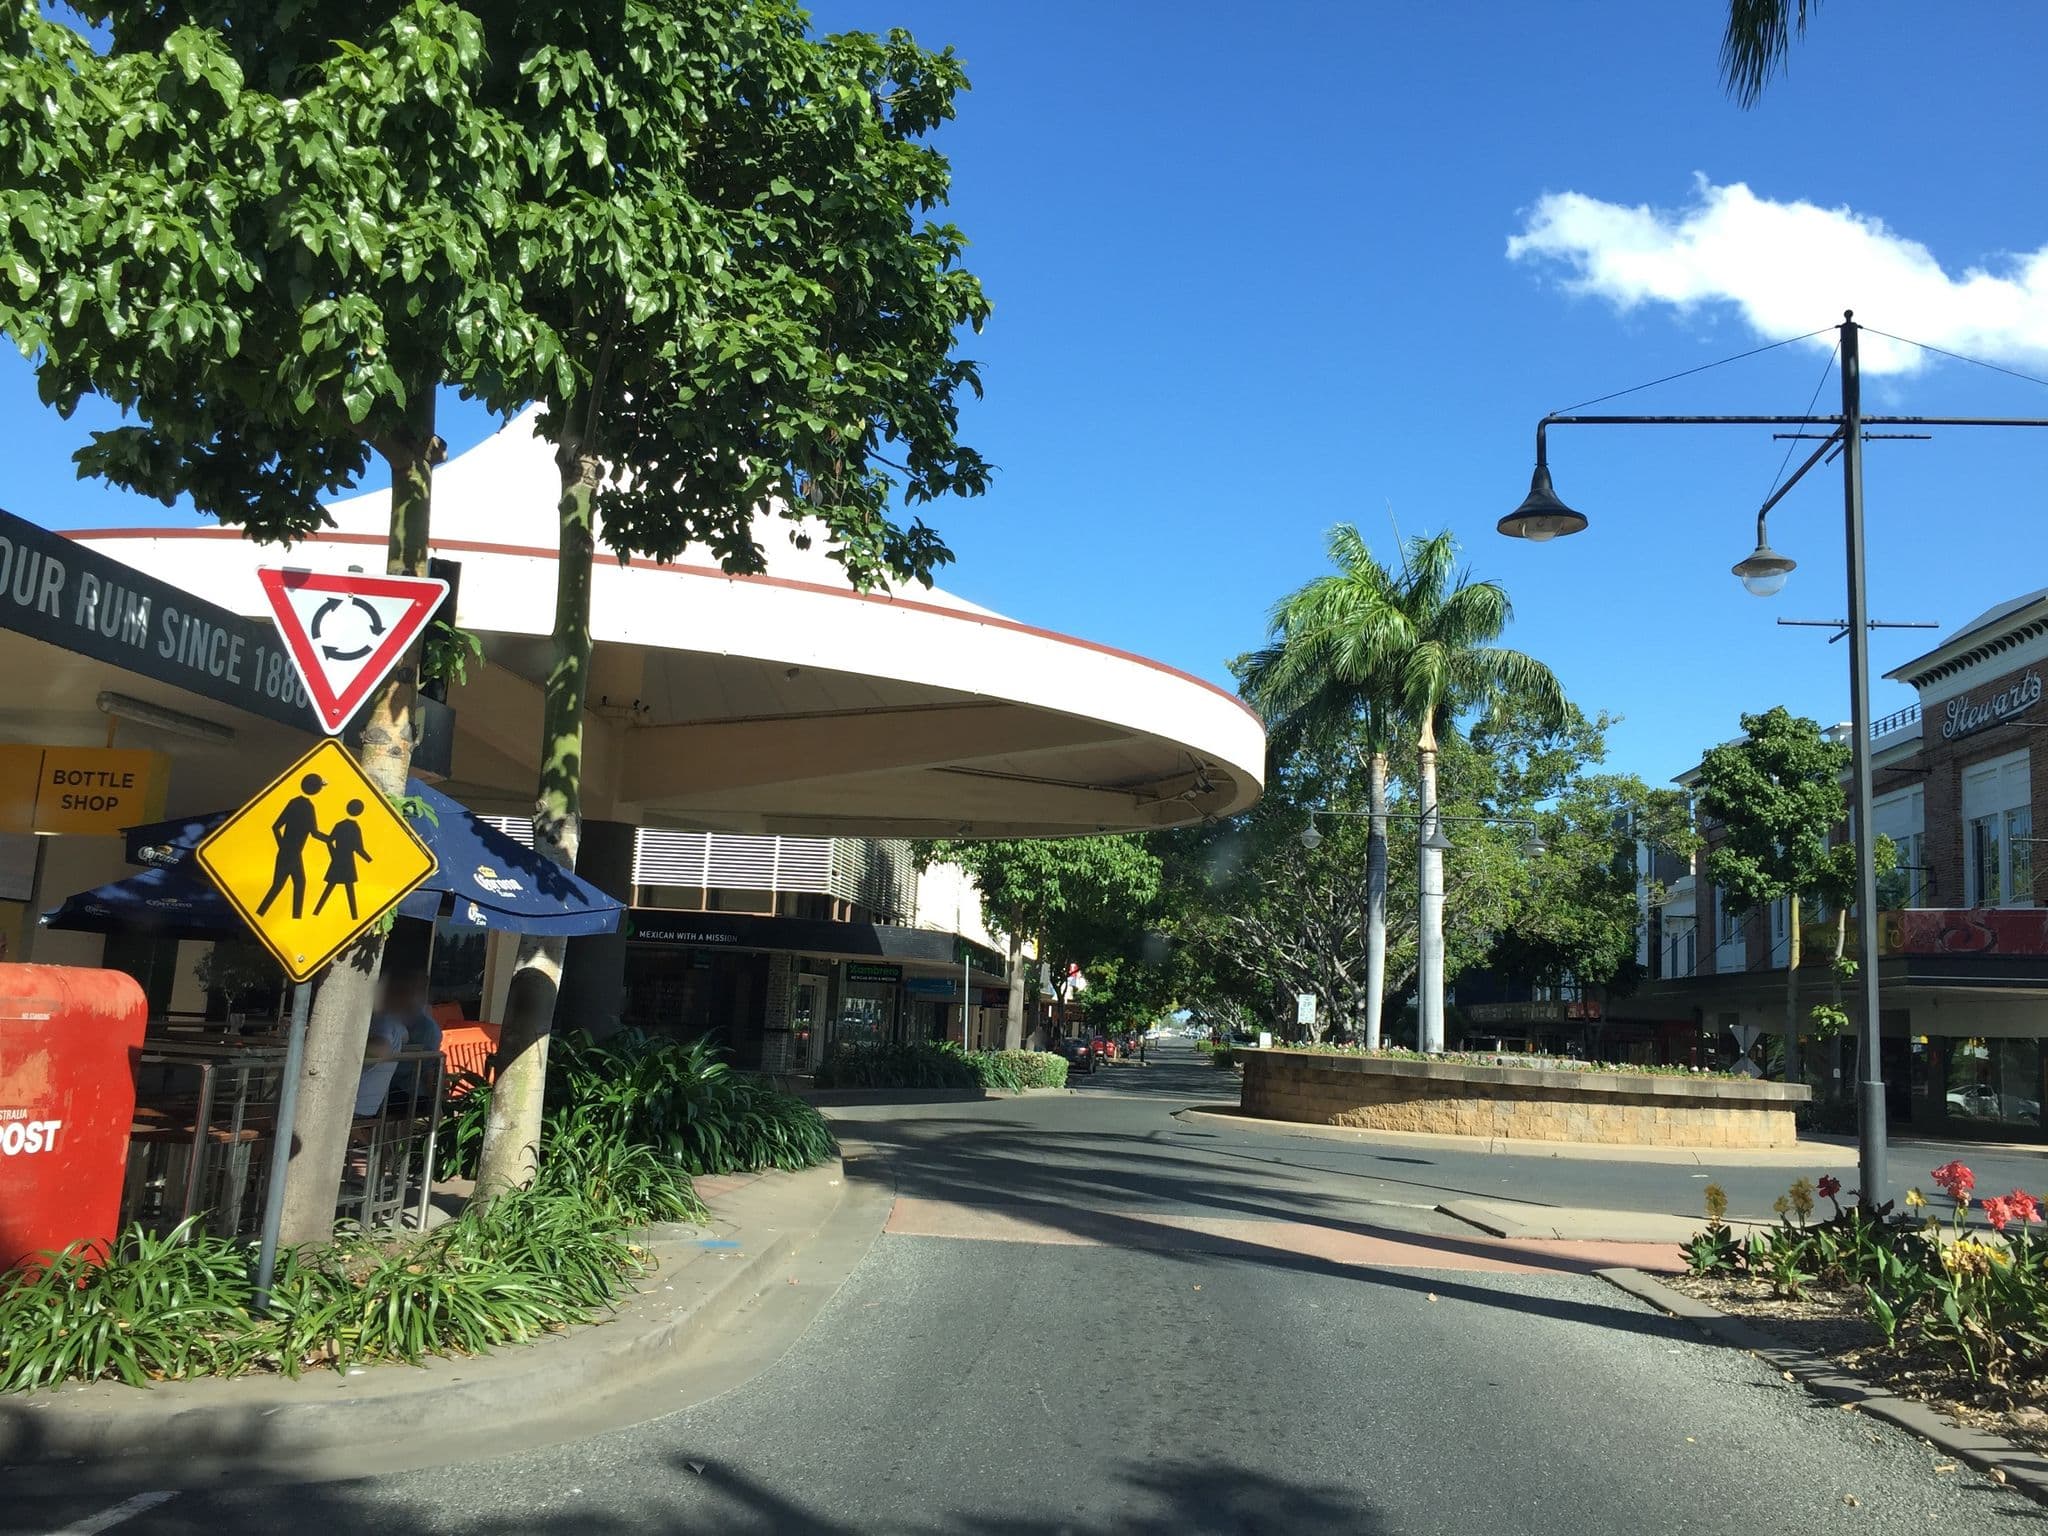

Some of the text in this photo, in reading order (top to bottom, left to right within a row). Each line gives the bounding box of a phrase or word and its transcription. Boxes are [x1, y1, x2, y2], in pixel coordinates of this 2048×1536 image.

[75, 571, 152, 649] RUM
[158, 607, 245, 685] SINCE
[53, 769, 135, 789] BOTTLE
[61, 794, 119, 812] SHOP
[639, 930, 738, 943] MEXICAN WITH A MISSION
